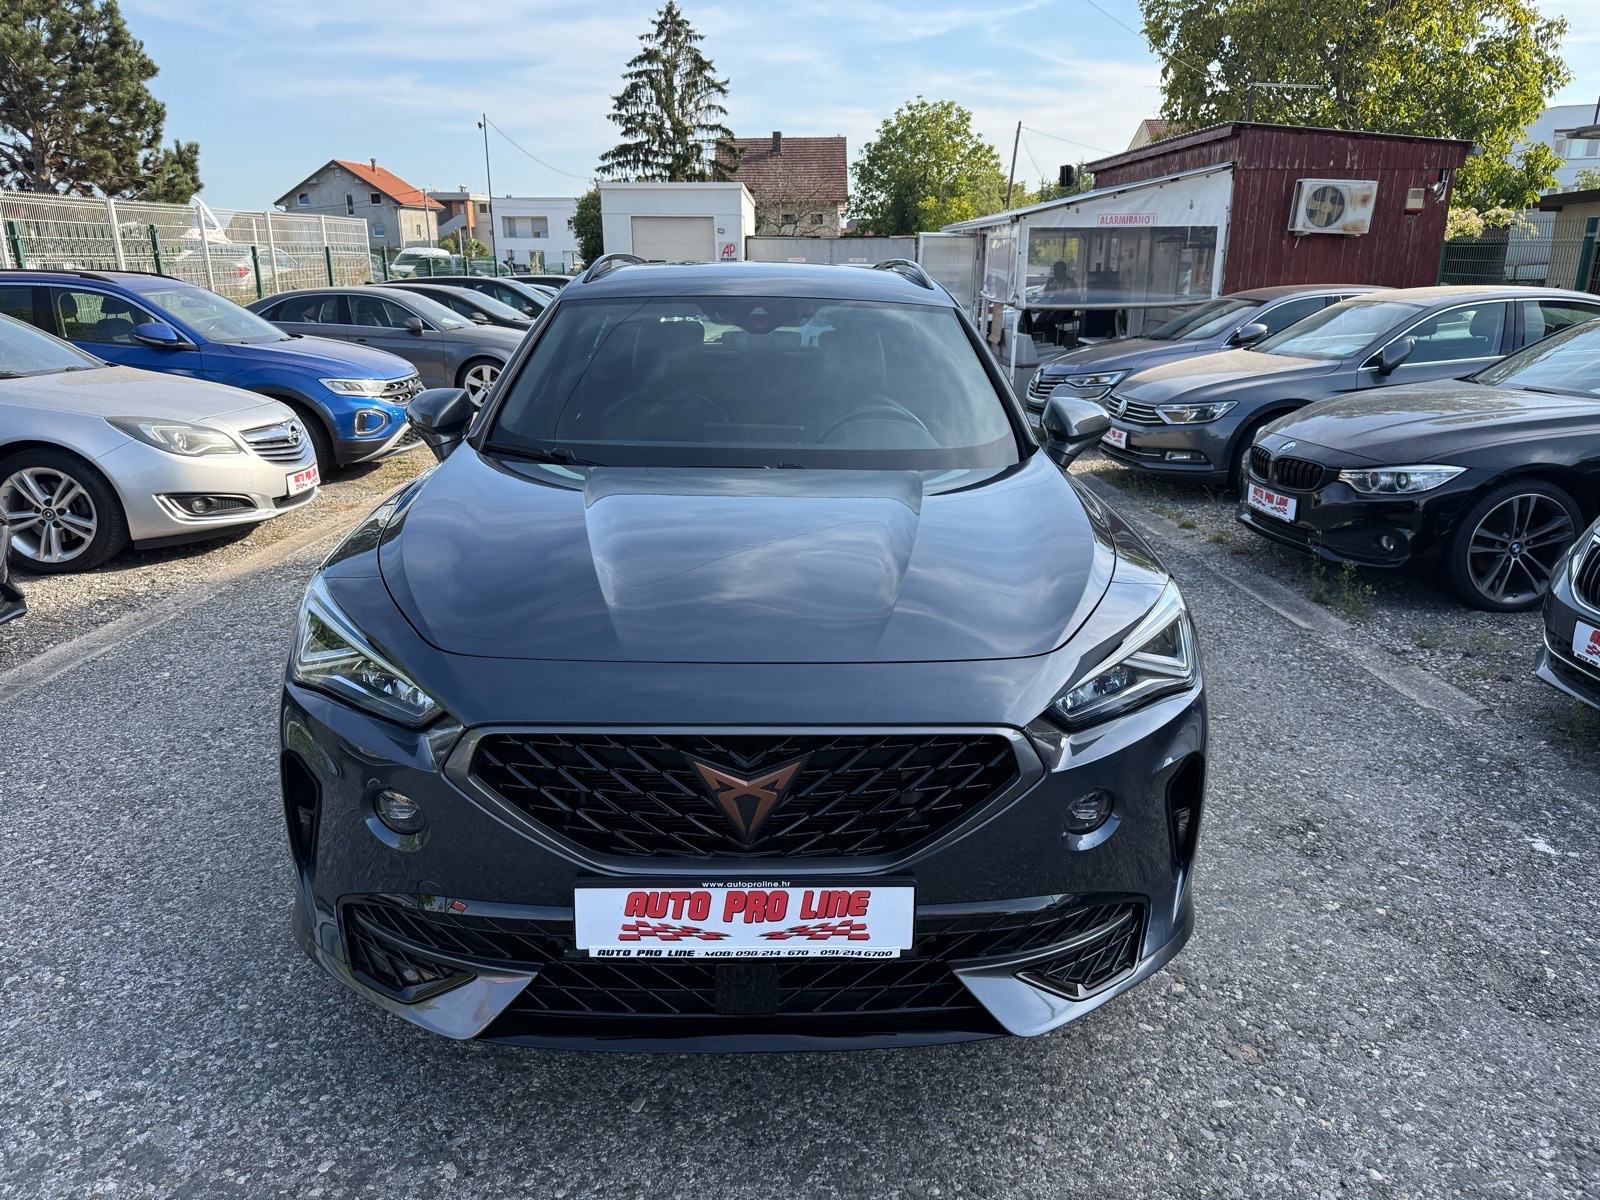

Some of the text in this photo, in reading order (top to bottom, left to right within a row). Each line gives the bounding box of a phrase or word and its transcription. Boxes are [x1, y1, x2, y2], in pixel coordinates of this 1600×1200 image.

[1100, 215, 1150, 225] ALARMIRANO
[721, 243, 736, 257] AP
[624, 890, 871, 923] AUTO PRO LINE
